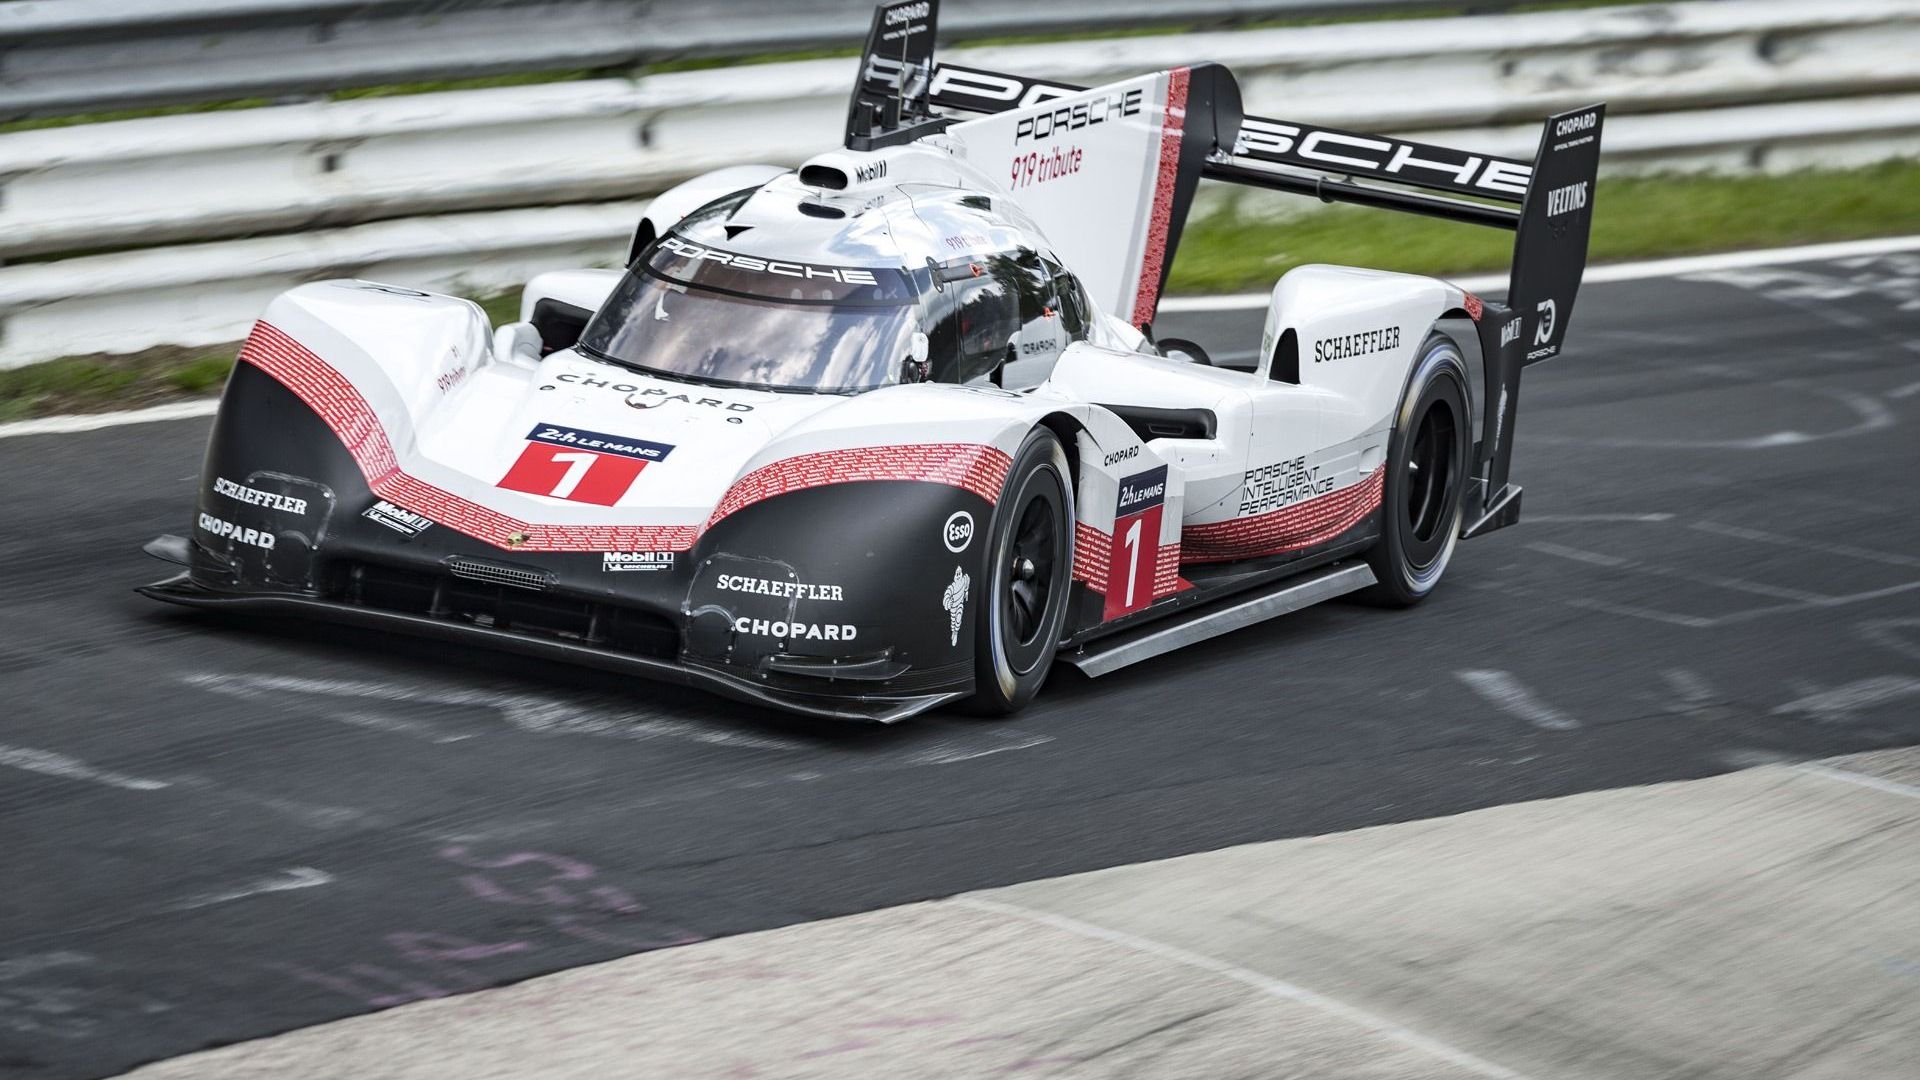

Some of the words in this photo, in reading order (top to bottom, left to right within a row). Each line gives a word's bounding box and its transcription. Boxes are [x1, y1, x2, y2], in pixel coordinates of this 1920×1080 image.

[1015, 89, 1143, 146] PORSCHE
[1556, 112, 1597, 136] CHOPARD
[1011, 152, 1037, 190] 919
[1038, 145, 1083, 182] tribute
[1547, 181, 1588, 217] VELTINS
[657, 237, 878, 286] PORSCHE
[1315, 326, 1400, 363] SCHAEFFLER
[1527, 345, 1556, 360] PORSCHE
[556, 374, 755, 412] CHOPARD
[577, 438, 605, 448] LE
[602, 442, 662, 457] MANS
[1104, 445, 1139, 467] CHOPARD
[551, 452, 600, 499] 1
[1242, 466, 1320, 501] INTELLIGENT
[1244, 455, 1306, 485] PORSCHE
[213, 477, 308, 515] SCHAEFFLER
[1134, 490, 1143, 503] LE
[1142, 483, 1164, 500] MANS
[1238, 477, 1334, 517] PERFORMANCE
[372, 500, 419, 525] Mobil
[199, 512, 276, 549] CHOPARD
[604, 552, 655, 562] Mobil
[1125, 518, 1143, 608] 1
[716, 575, 844, 601] SCHAEFFLER
[735, 617, 858, 641] CHOPARD
